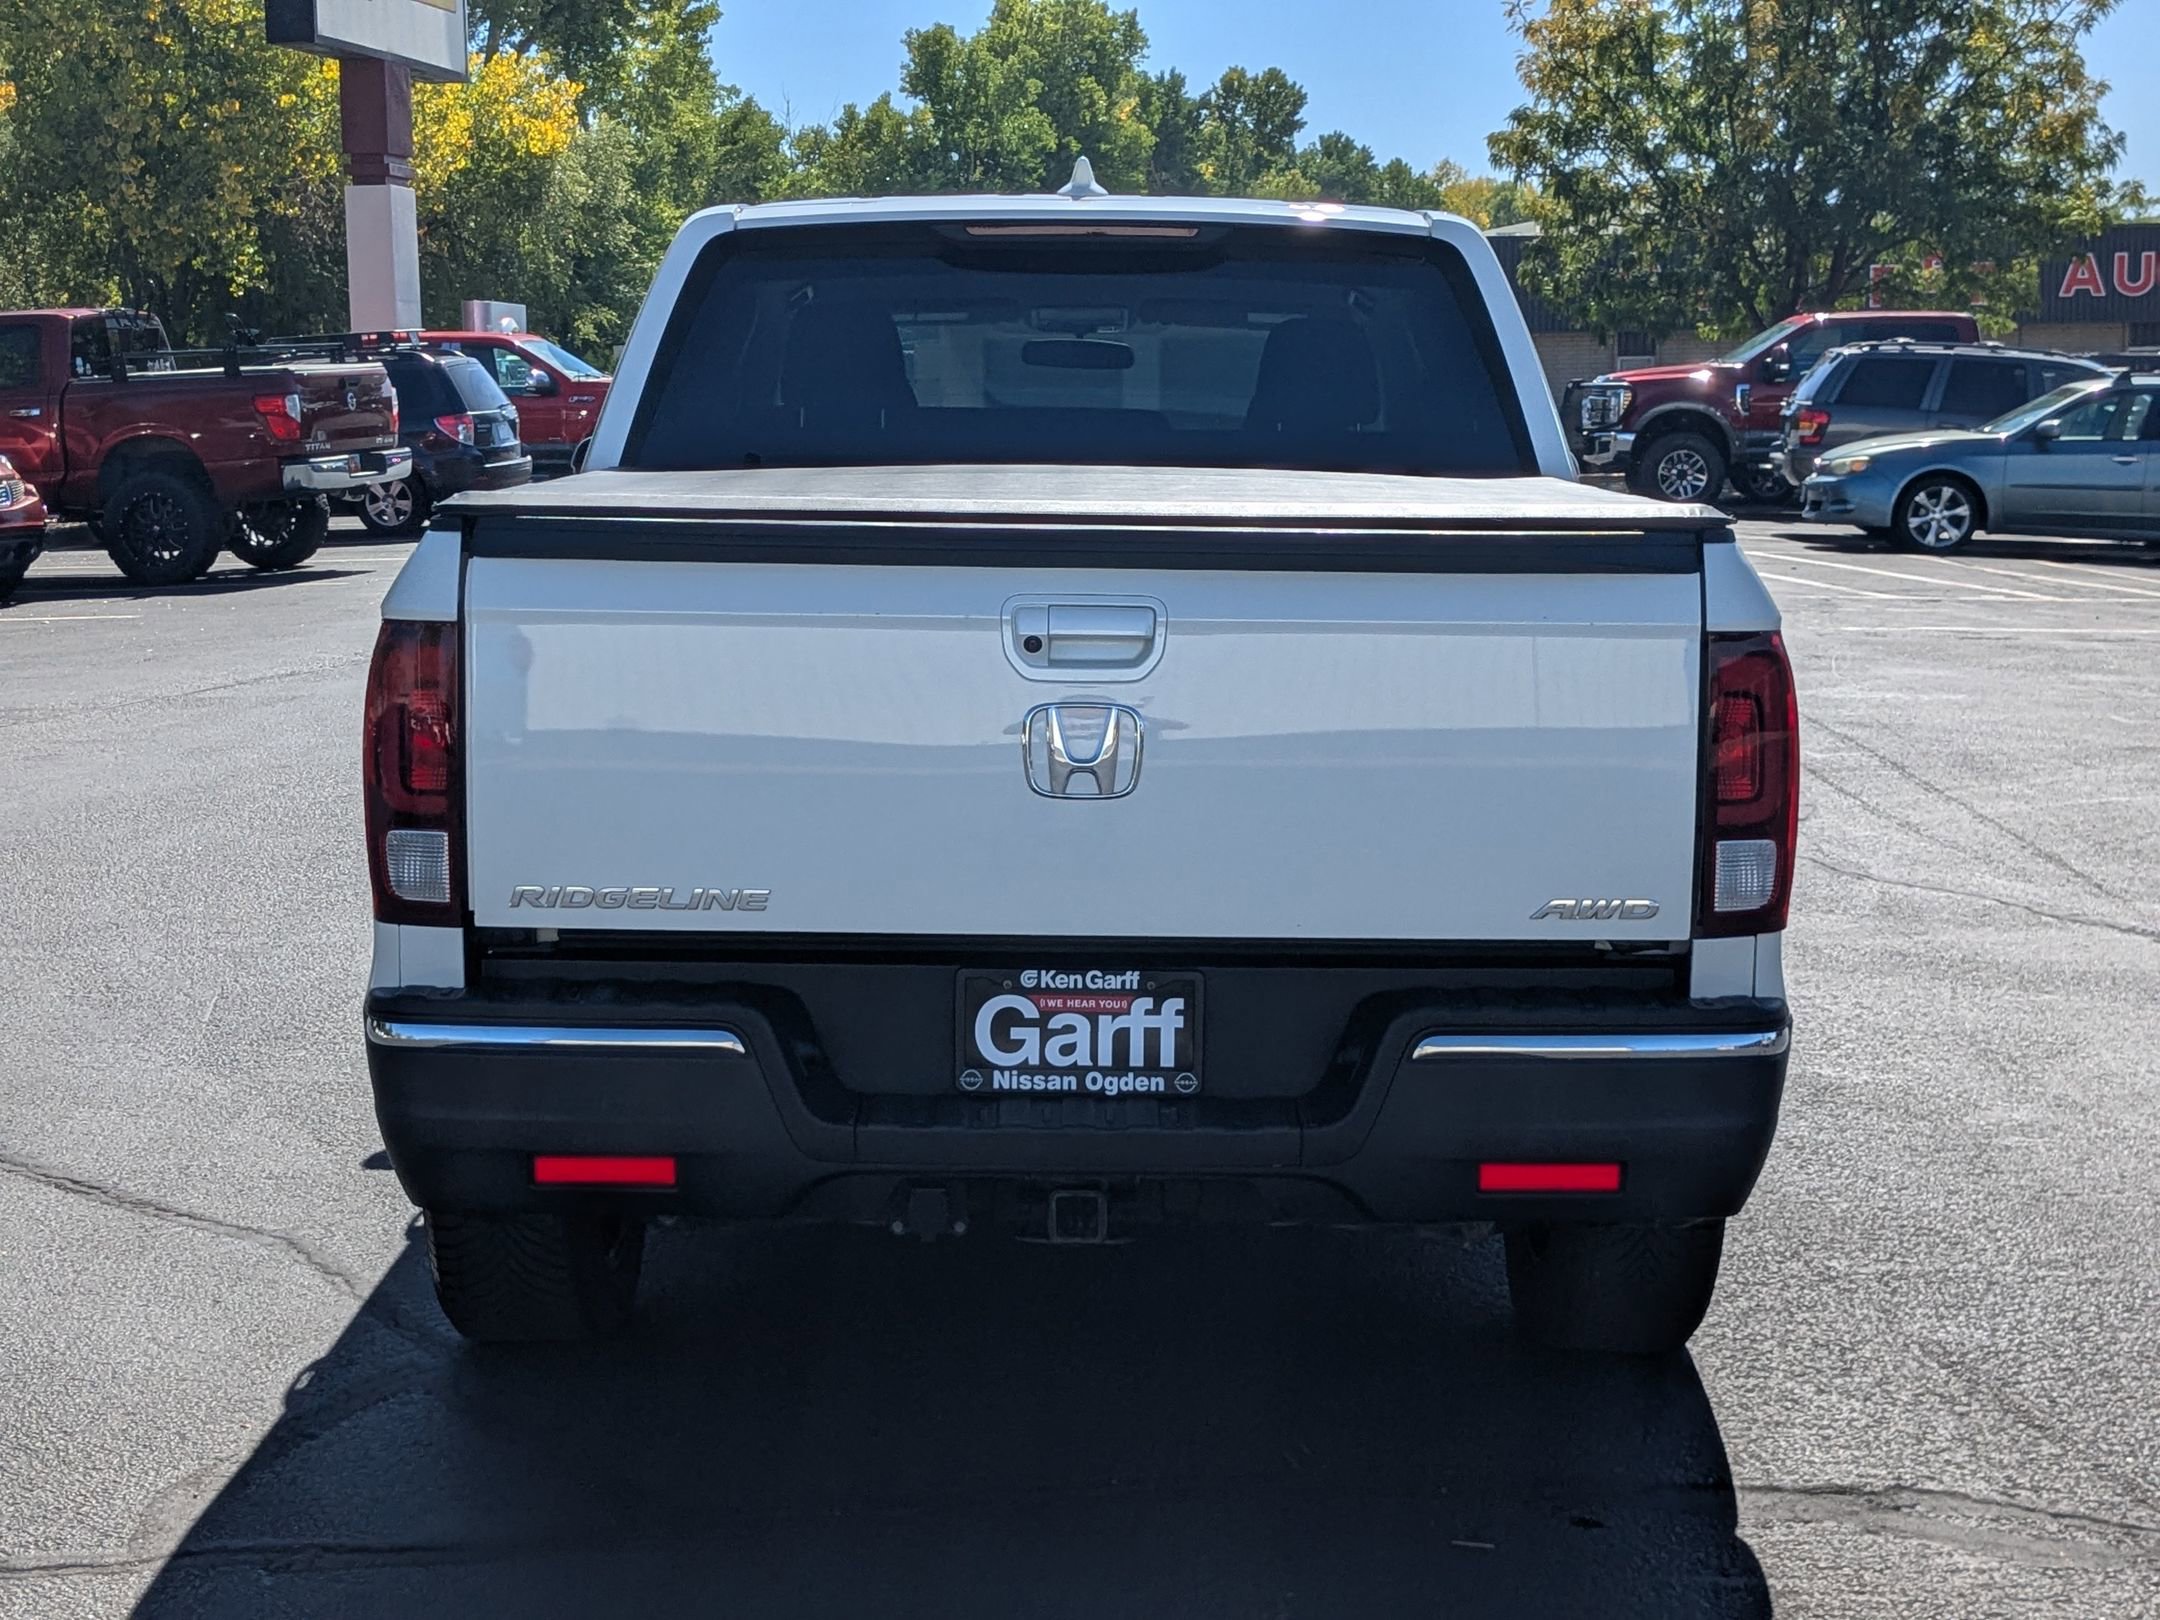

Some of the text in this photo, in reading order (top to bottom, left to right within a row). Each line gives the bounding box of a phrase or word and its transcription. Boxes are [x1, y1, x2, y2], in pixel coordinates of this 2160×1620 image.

[305, 442, 331, 452] TITAN
[509, 884, 771, 912] RIDGELINE
[1529, 898, 1660, 920] AWD
[1040, 970, 1140, 990] Ken Garff
[1047, 999, 1120, 1009] WE HEAR YOU
[974, 994, 1185, 1068] Garff
[993, 1069, 1165, 1096] Nissan Ogden
